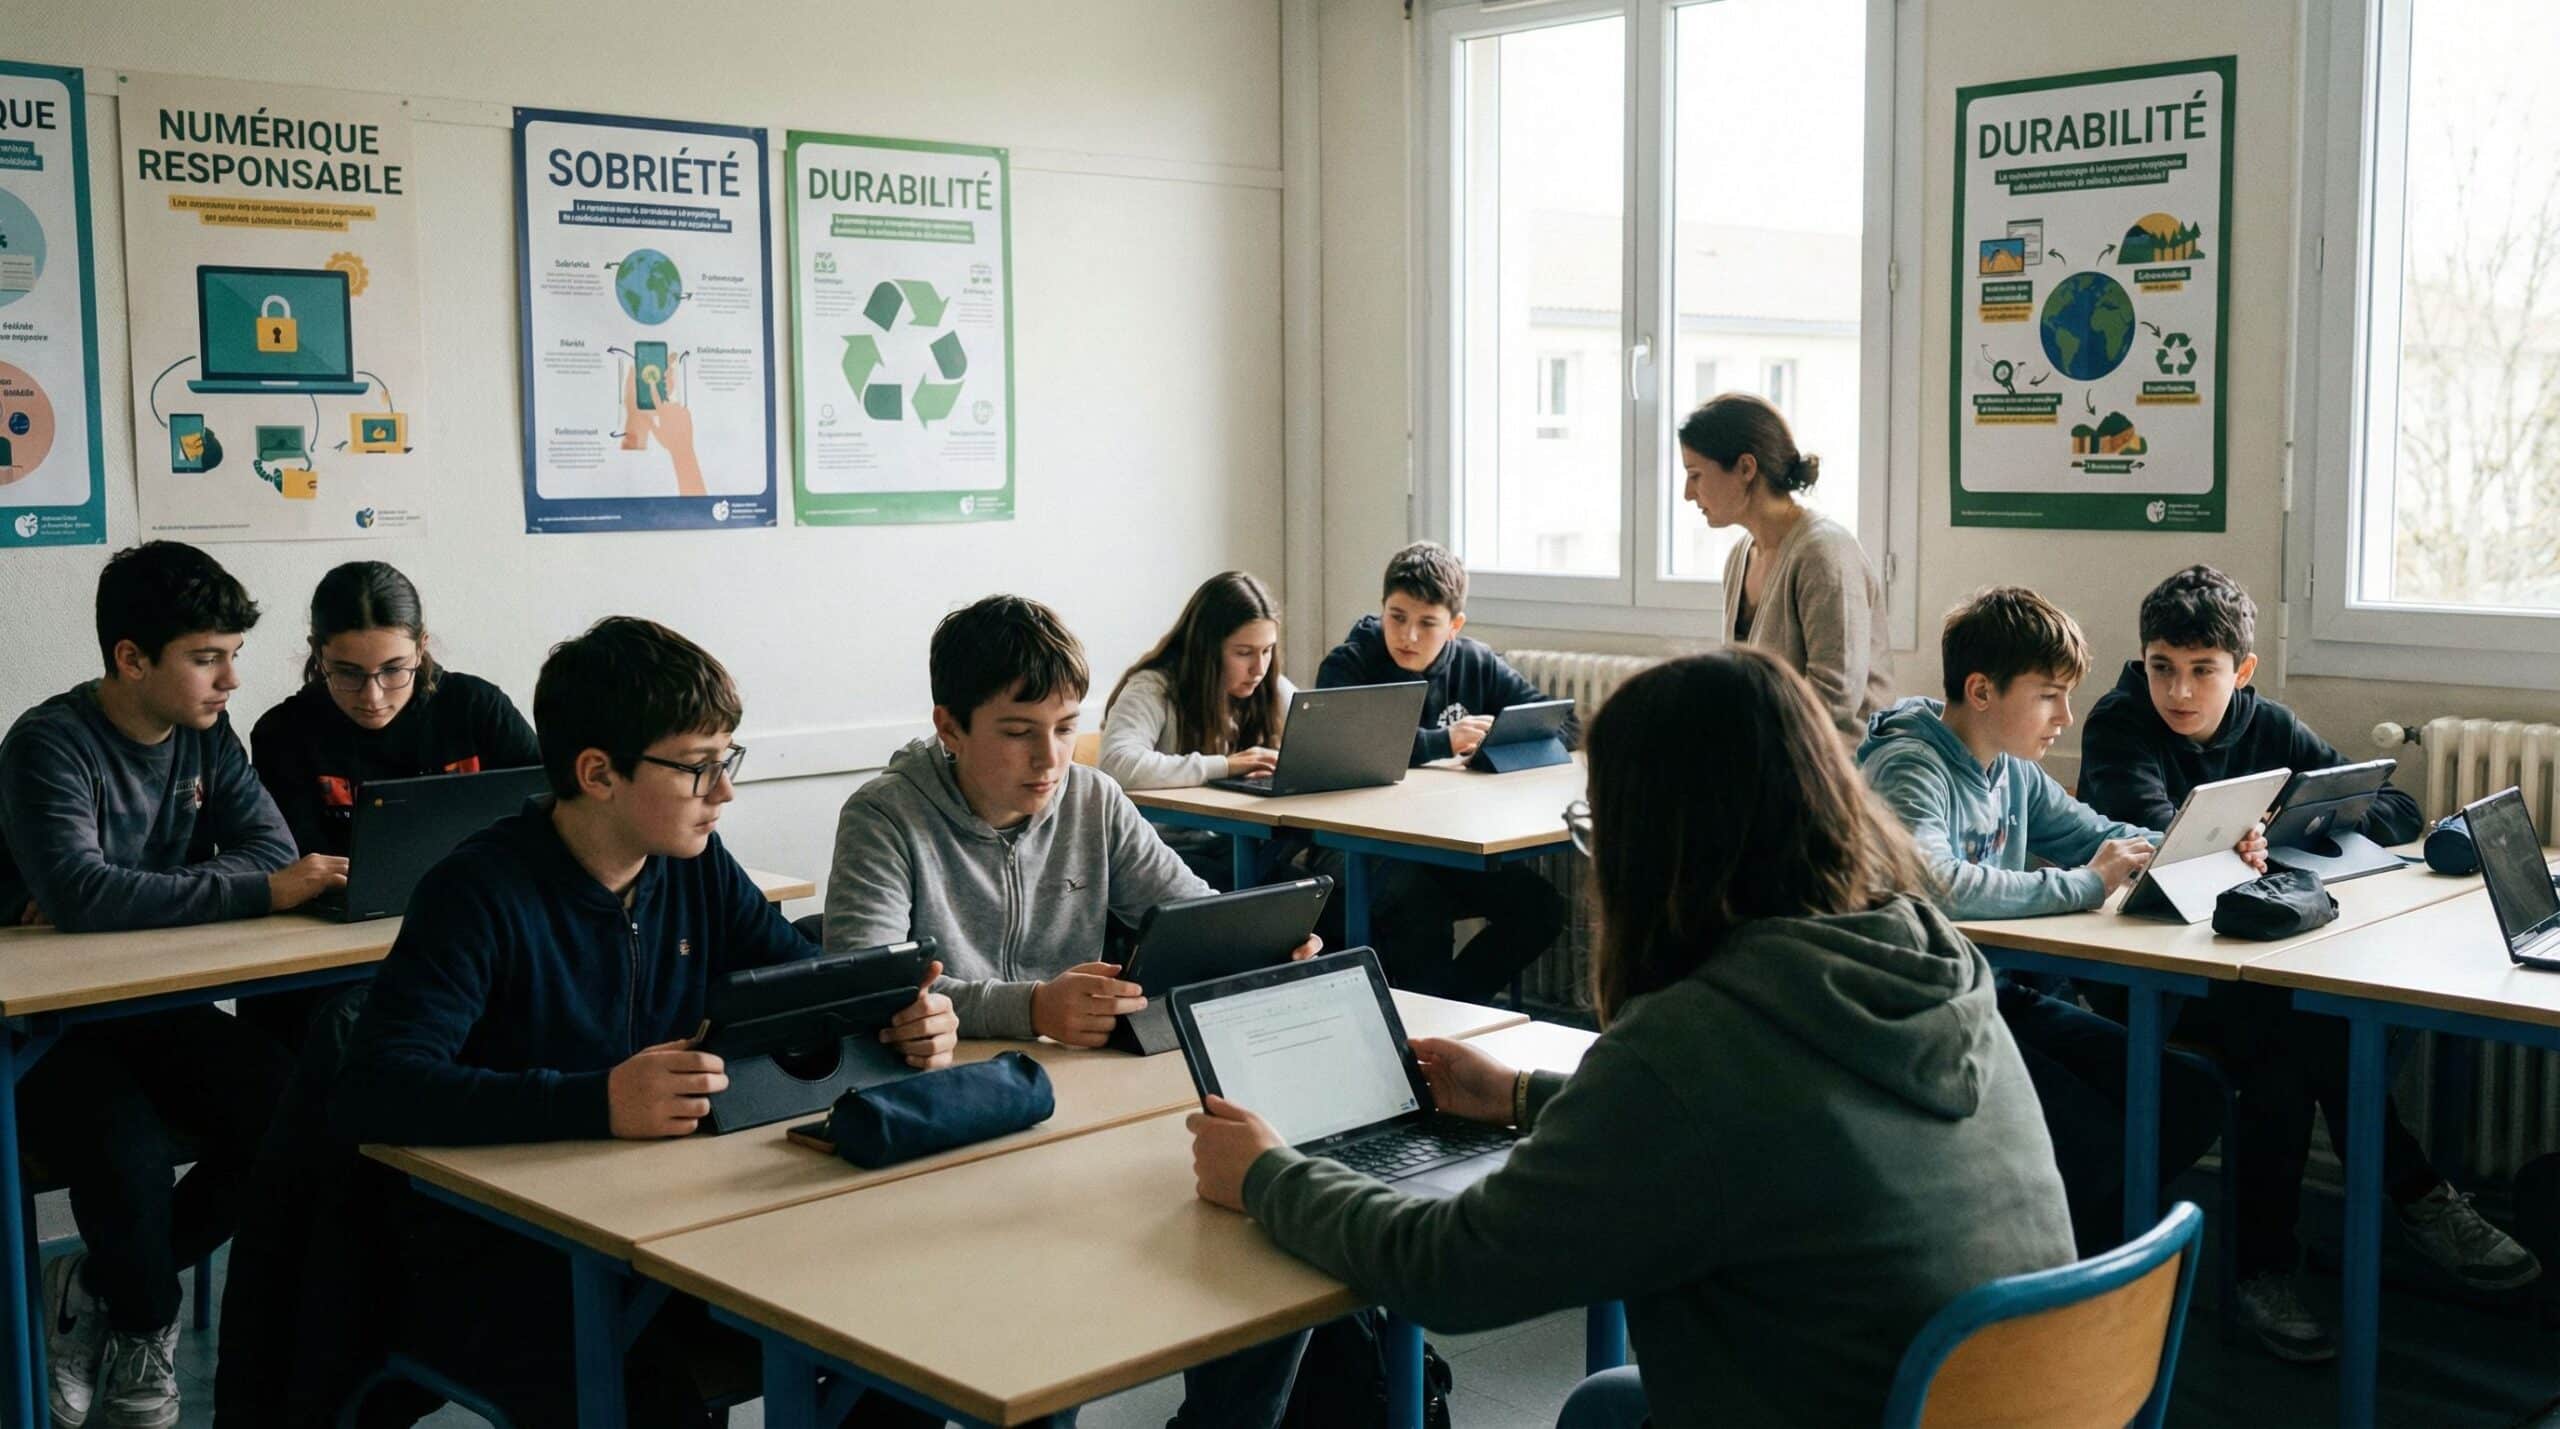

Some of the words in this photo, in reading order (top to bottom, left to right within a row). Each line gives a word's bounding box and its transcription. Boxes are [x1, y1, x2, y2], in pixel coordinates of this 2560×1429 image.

[159, 108, 379, 156] NUMÉRIQUE
[1979, 90, 2207, 159] DURABILITÉ
[138, 149, 403, 196] RESPONSABLE
[548, 147, 740, 197] SOBRIÉTÉ
[809, 167, 993, 211] DURABILITÉ
